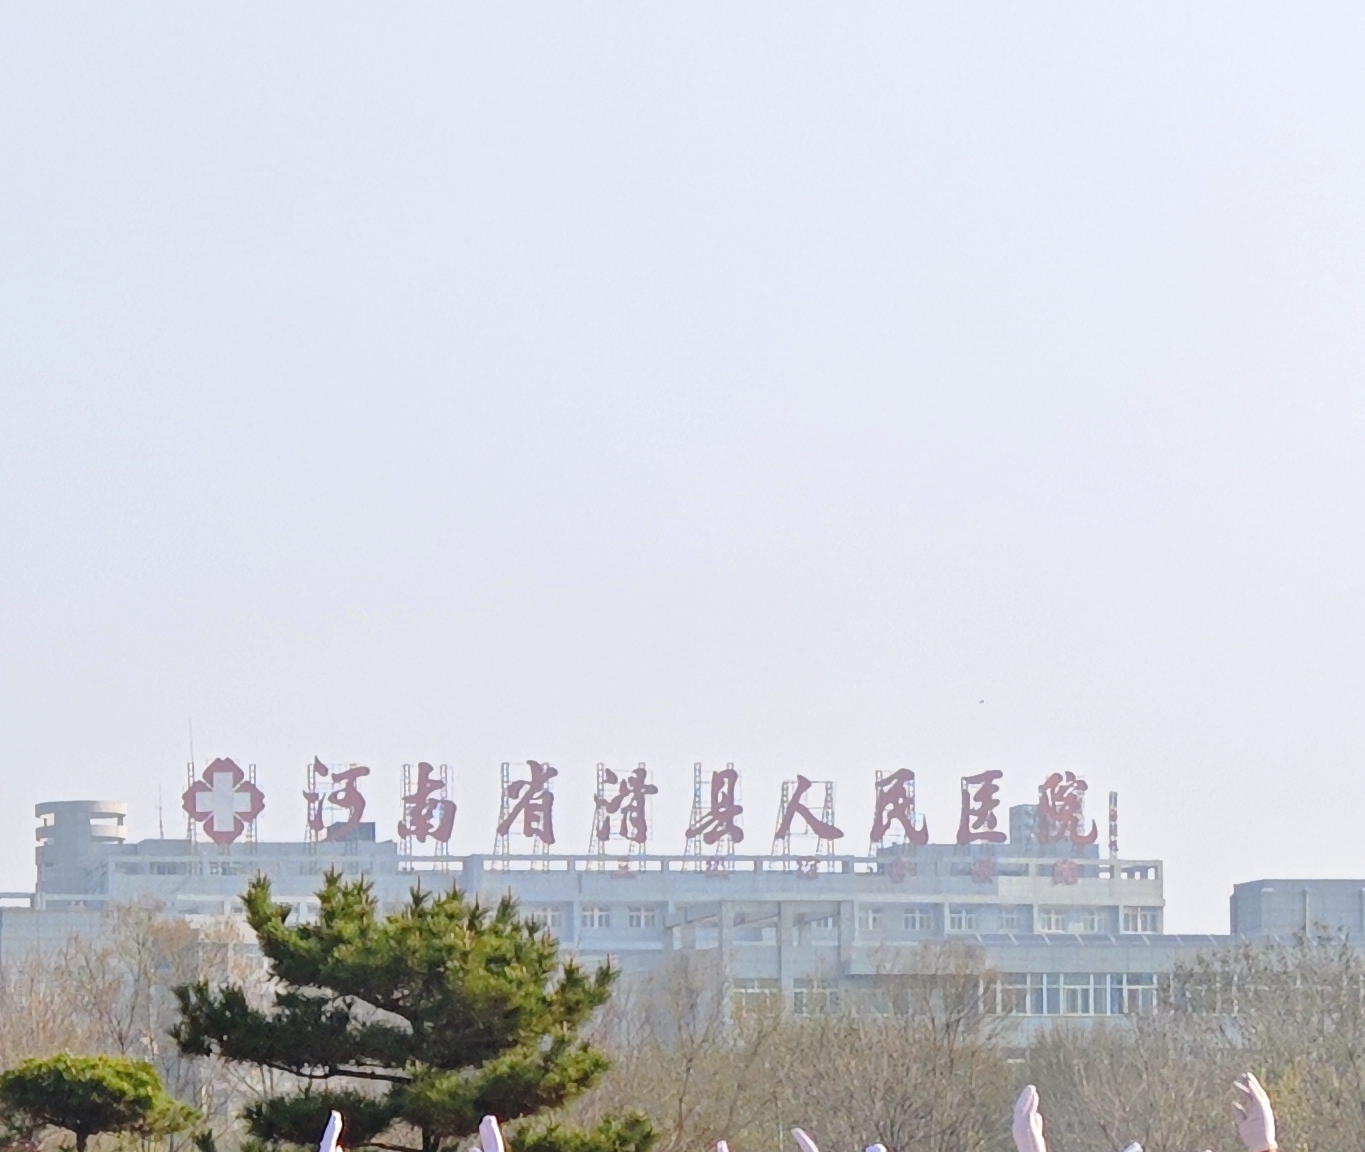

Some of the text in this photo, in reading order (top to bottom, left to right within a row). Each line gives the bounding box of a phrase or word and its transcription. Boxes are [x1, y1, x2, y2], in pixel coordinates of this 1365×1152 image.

[303, 755, 1098, 846] 河南省滑县人民医院
